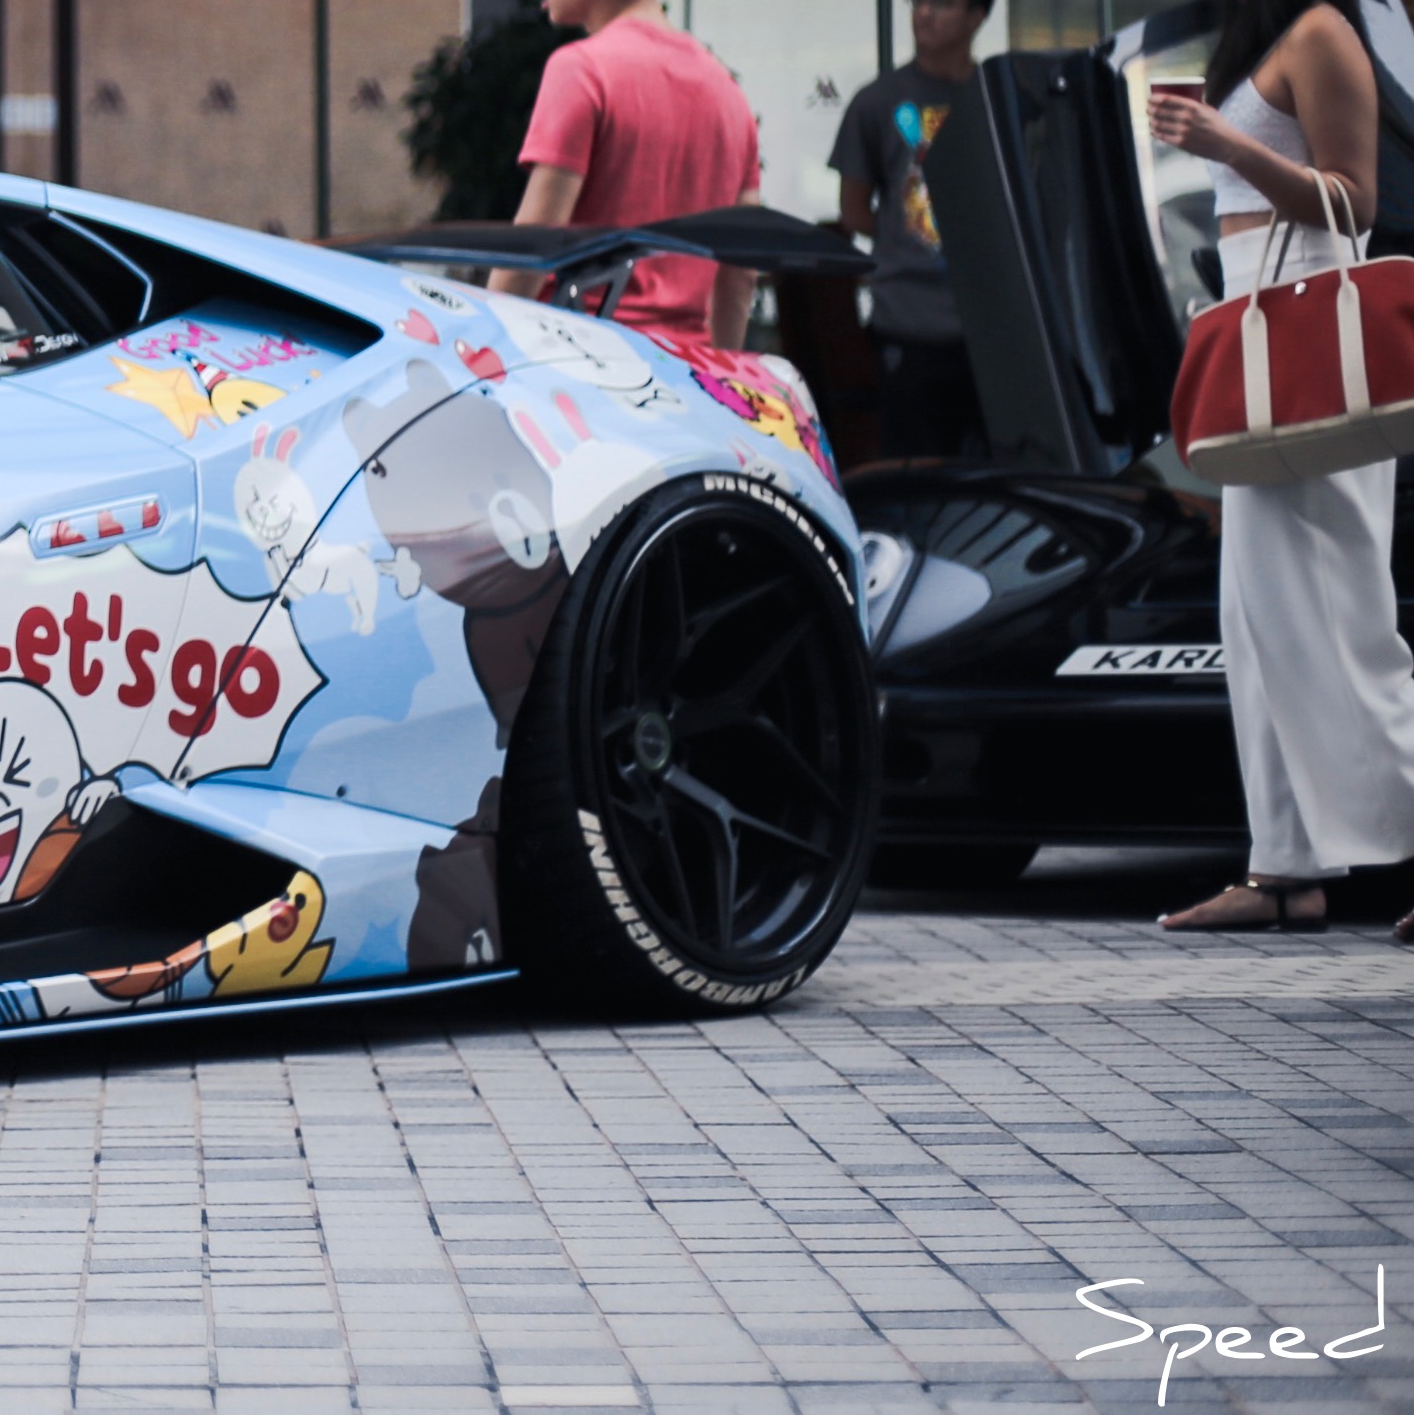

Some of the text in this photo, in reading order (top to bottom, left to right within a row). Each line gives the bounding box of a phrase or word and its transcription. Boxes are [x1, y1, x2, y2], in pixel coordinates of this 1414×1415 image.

[168, 638, 280, 738] go
[1091, 648, 1227, 670] KARL
[577, 808, 809, 1005] LAMBORGHINI
